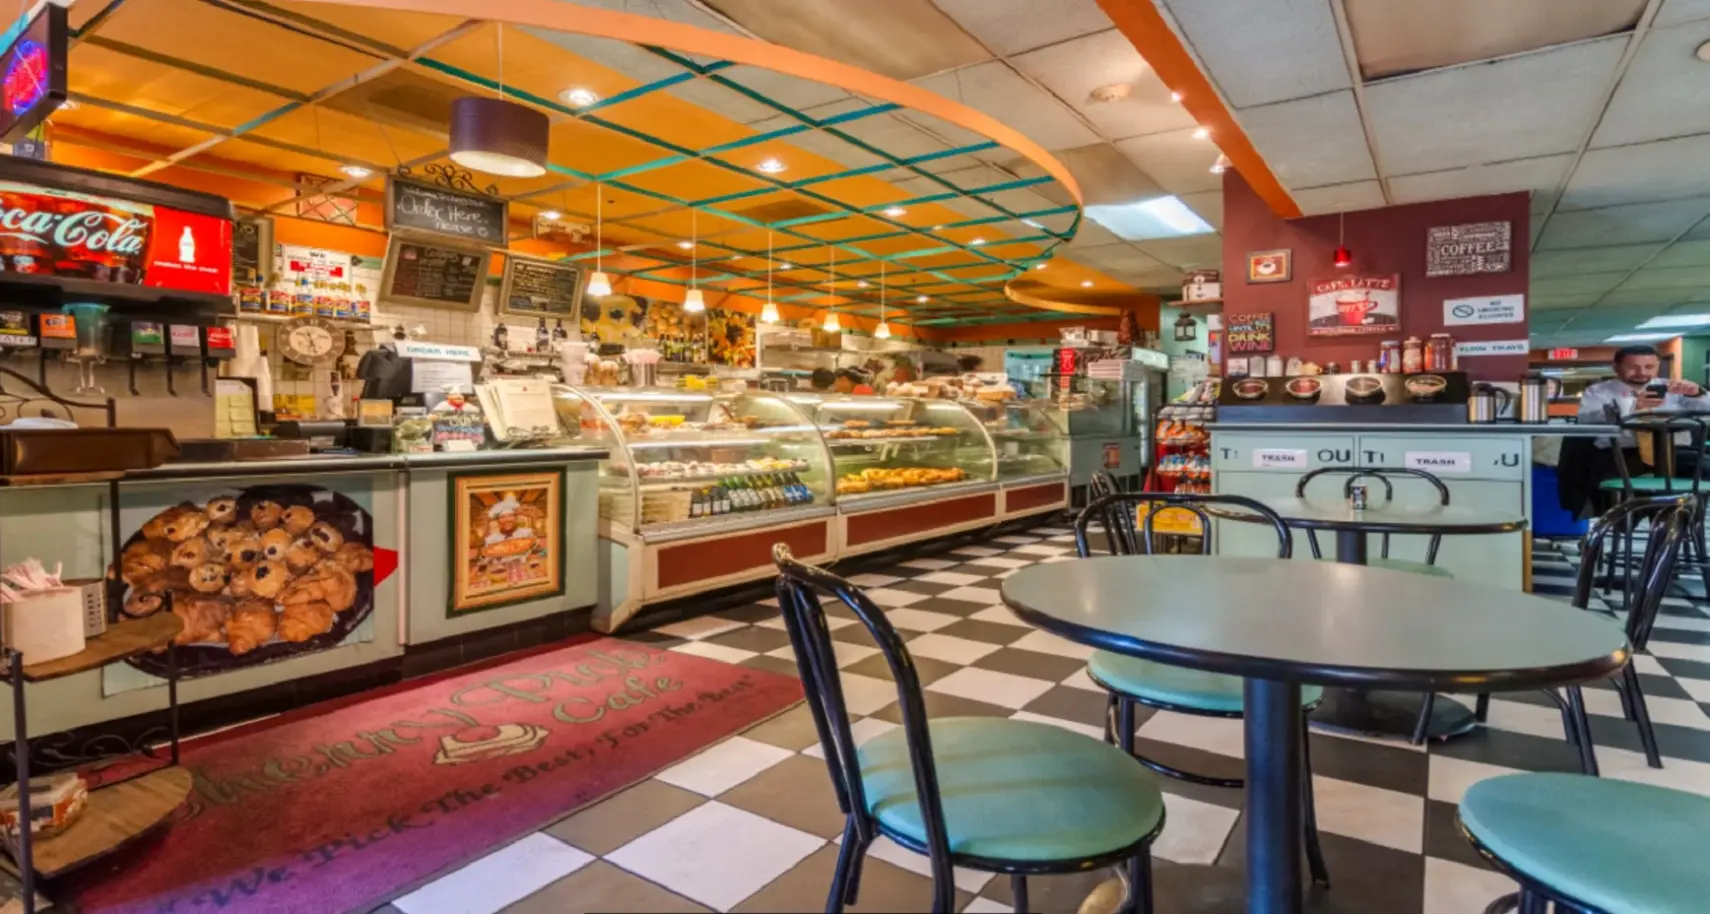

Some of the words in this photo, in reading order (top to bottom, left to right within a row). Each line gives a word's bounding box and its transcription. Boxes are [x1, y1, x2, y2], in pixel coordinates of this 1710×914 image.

[401, 195, 443, 220] Order
[447, 205, 482, 223] Here
[0, 206, 149, 254] ca-Cola
[1441, 242, 1495, 255] COFFEE
[1228, 332, 1271, 343] DRINK
